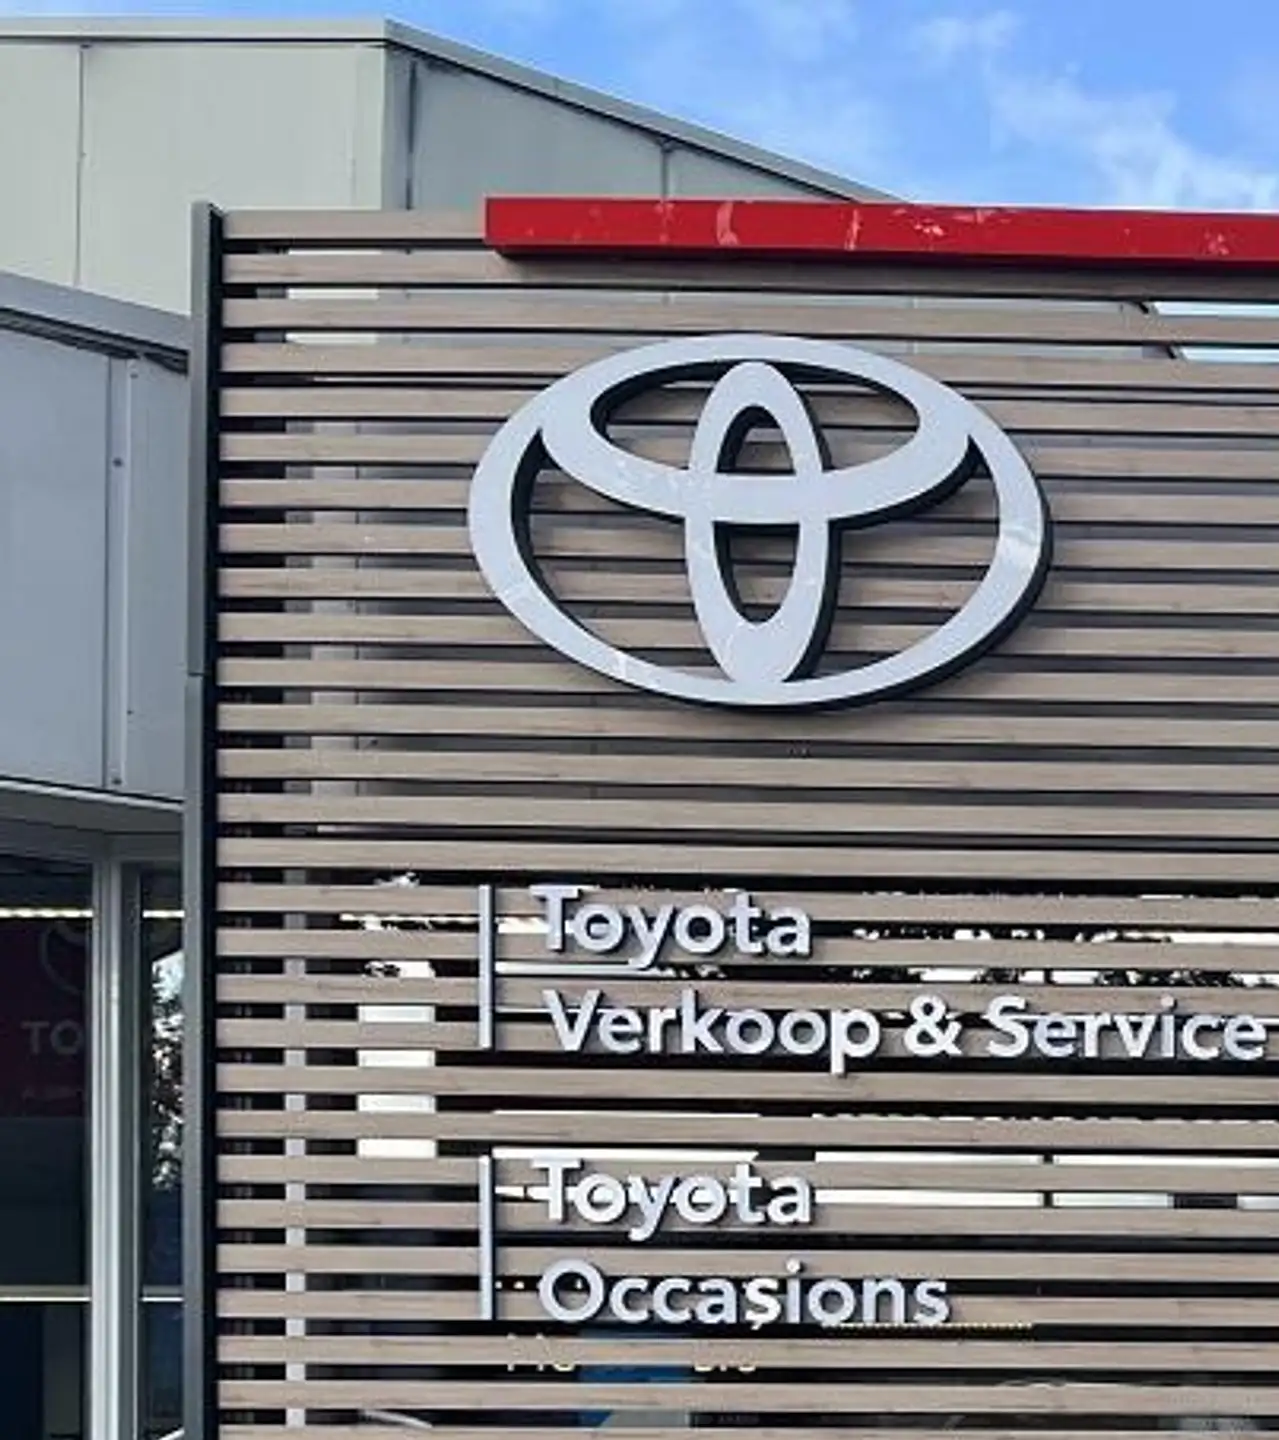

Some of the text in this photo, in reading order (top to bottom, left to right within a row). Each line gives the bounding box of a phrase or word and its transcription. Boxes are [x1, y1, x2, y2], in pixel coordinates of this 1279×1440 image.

[530, 884, 812, 969] Toyota
[542, 988, 1267, 1074] Verkoop & Service
[531, 1157, 813, 1242] Toyota
[538, 1258, 951, 1325] Occasions
